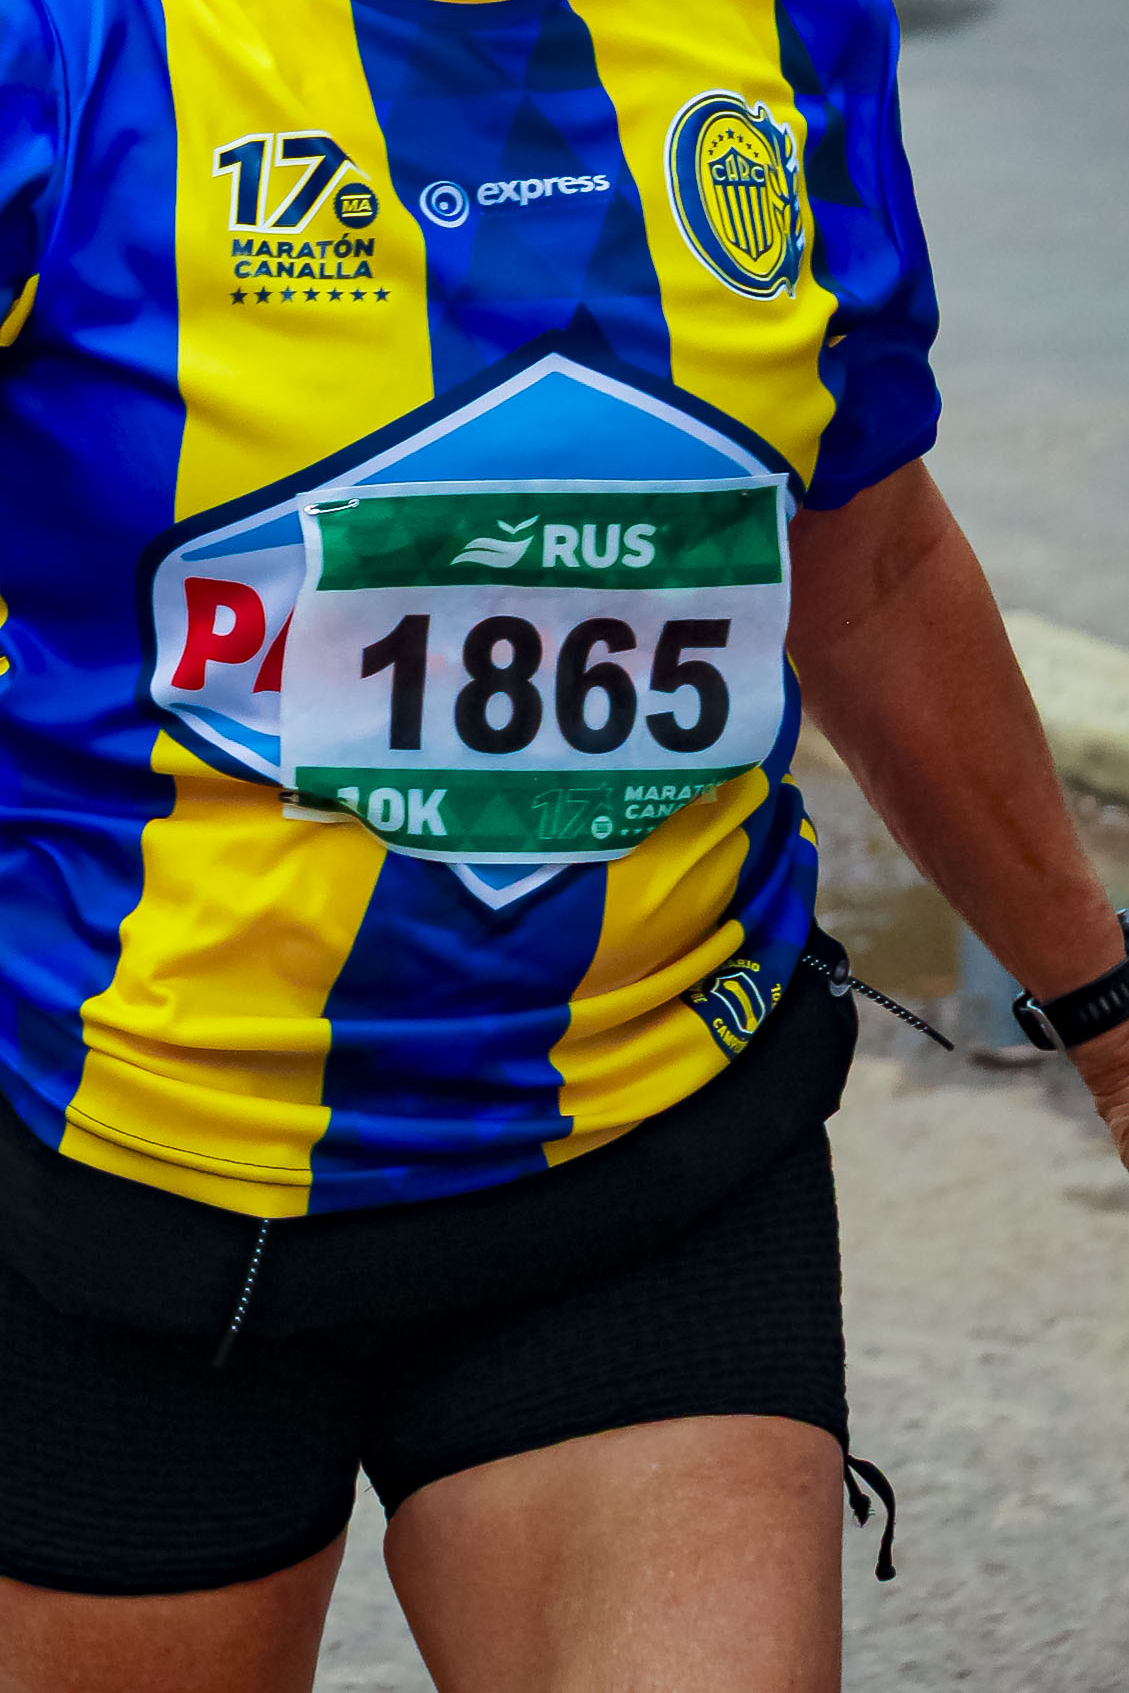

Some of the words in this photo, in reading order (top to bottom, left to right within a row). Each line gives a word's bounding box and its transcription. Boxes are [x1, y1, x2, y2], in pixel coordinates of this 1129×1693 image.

[212, 129, 352, 234] 17
[711, 153, 765, 183] CARC
[477, 174, 611, 206] express
[231, 233, 376, 259] MARATÓN
[233, 259, 374, 280] CANALLA
[543, 522, 658, 569] RUS
[359, 613, 733, 755] 1865
